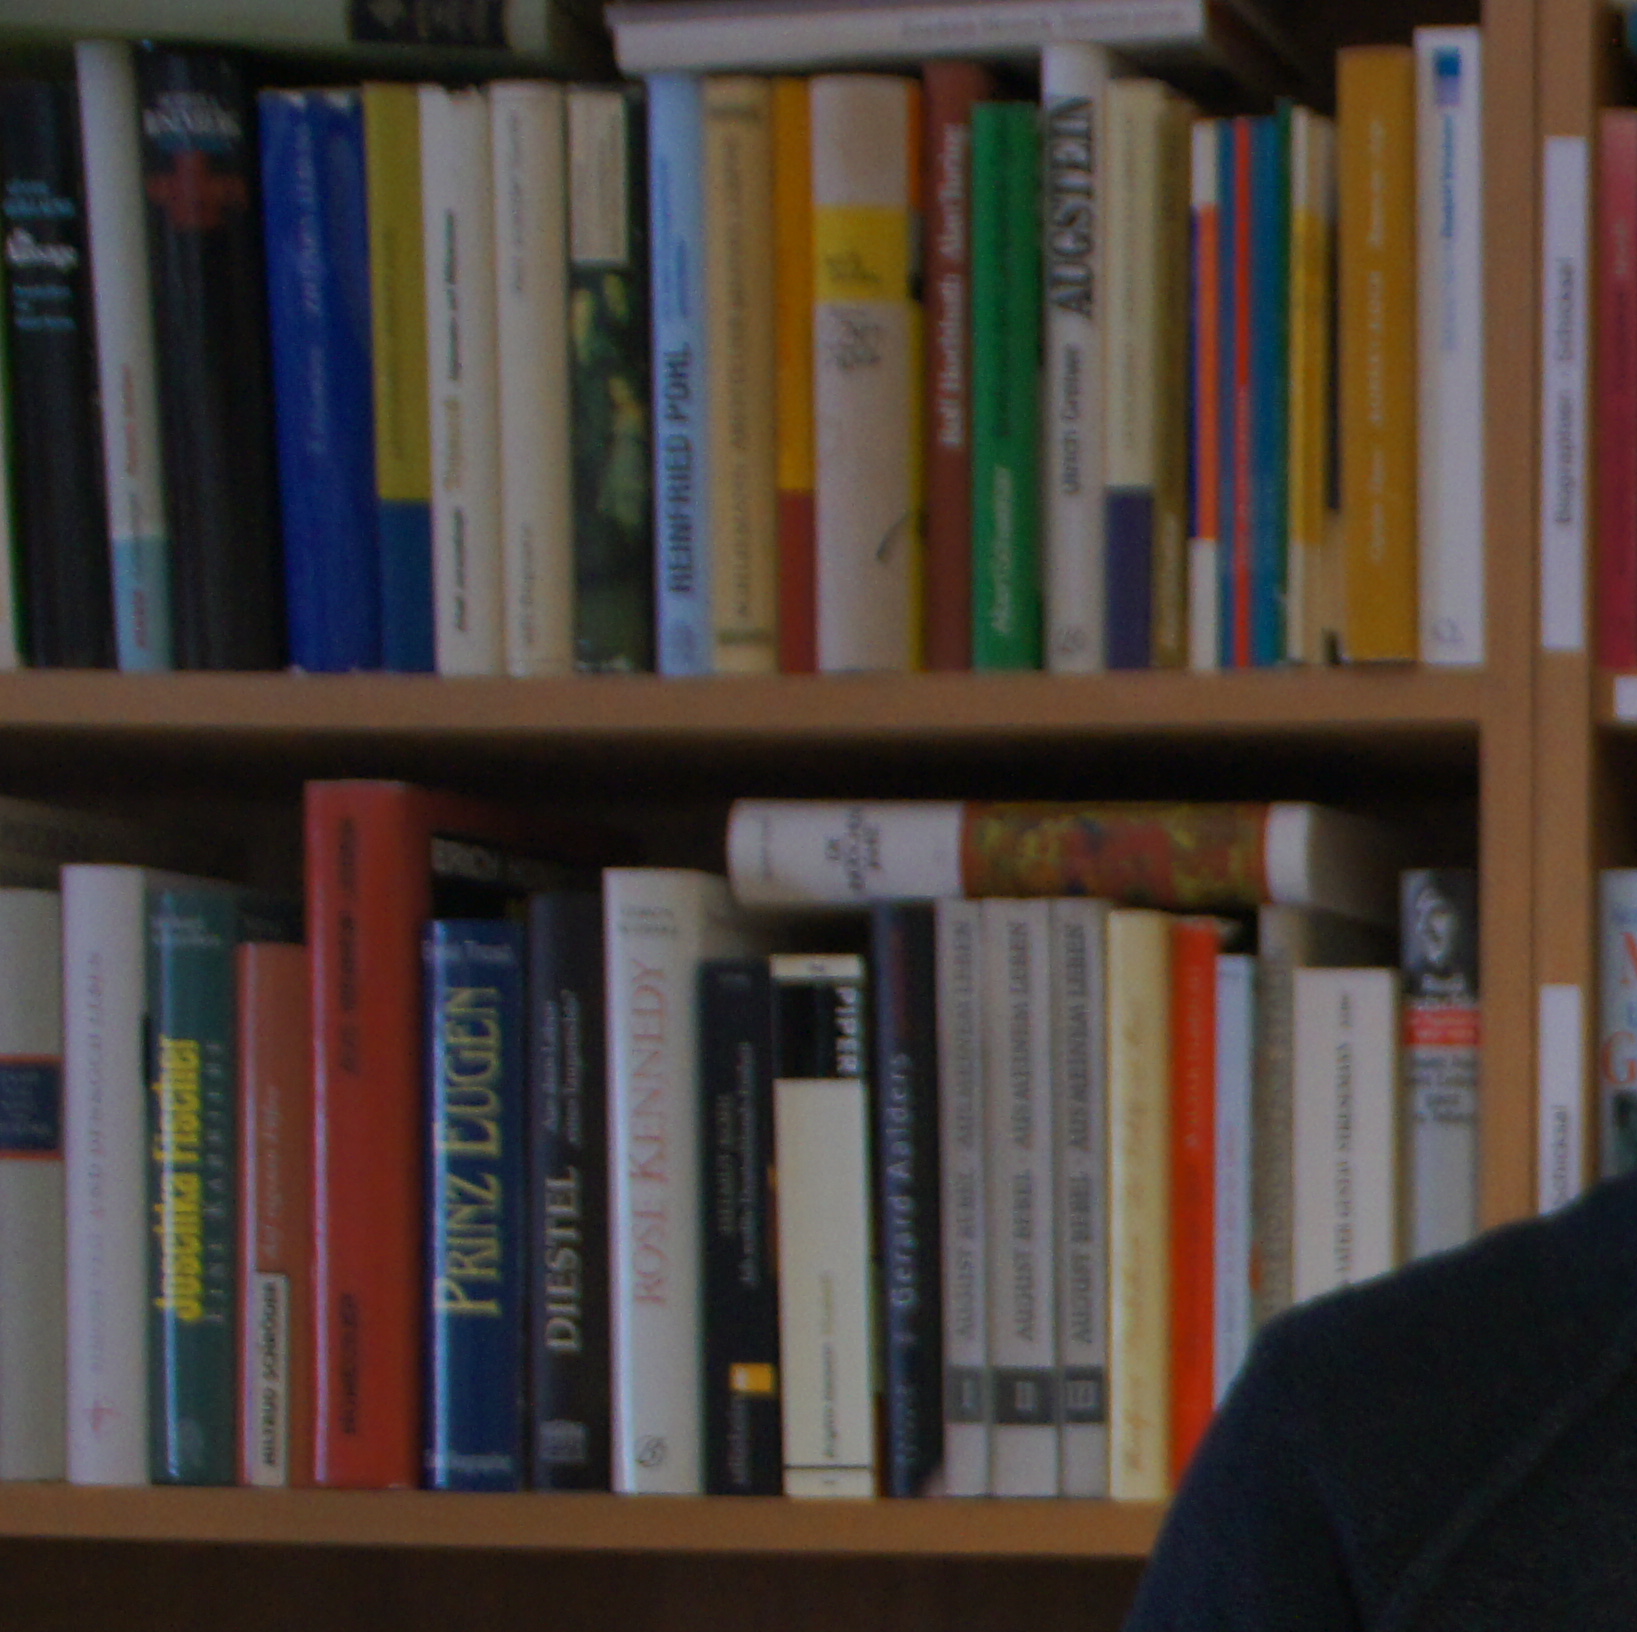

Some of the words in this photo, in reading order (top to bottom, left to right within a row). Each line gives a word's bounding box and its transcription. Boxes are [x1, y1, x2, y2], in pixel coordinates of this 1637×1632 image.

[1046, 96, 1096, 318] AUGSTEIN
[154, 1035, 203, 1163] Fischer
[433, 984, 503, 1152] EUGEN
[629, 959, 668, 1188] KENNEDY
[154, 1173, 203, 1321] Joschka
[434, 1176, 503, 1316] PRINZ
[543, 1167, 581, 1354] DIESTEL
[632, 1200, 668, 1310] ROSE
[887, 1197, 917, 1307] Gerard
